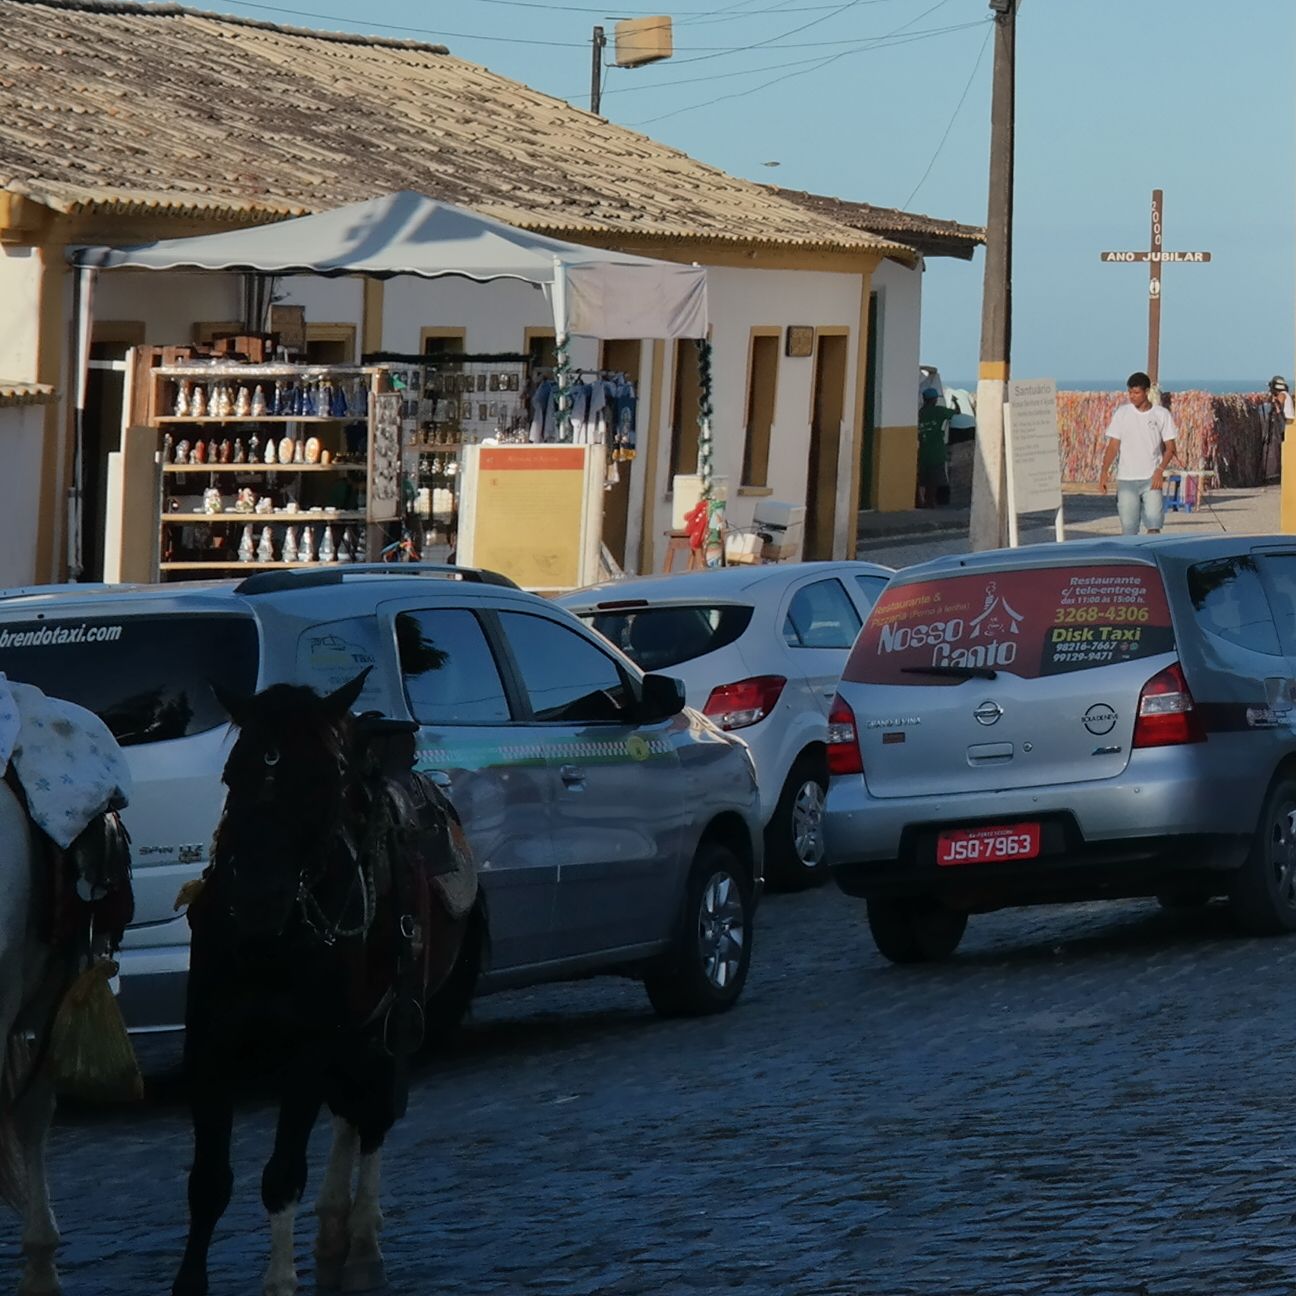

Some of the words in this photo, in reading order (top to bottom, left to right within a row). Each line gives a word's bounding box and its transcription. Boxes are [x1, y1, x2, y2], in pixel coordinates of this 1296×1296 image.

[1106, 252, 1135, 261] ANO
[1142, 252, 1204, 262] JUBILAR
[1070, 576, 1142, 585] Restaurante
[1075, 585, 1147, 596] tele-entrega
[1055, 606, 1149, 623] 3268-4306
[877, 618, 964, 655] Nosso
[1051, 627, 1095, 642] Disk
[1099, 627, 1142, 641] Taxi
